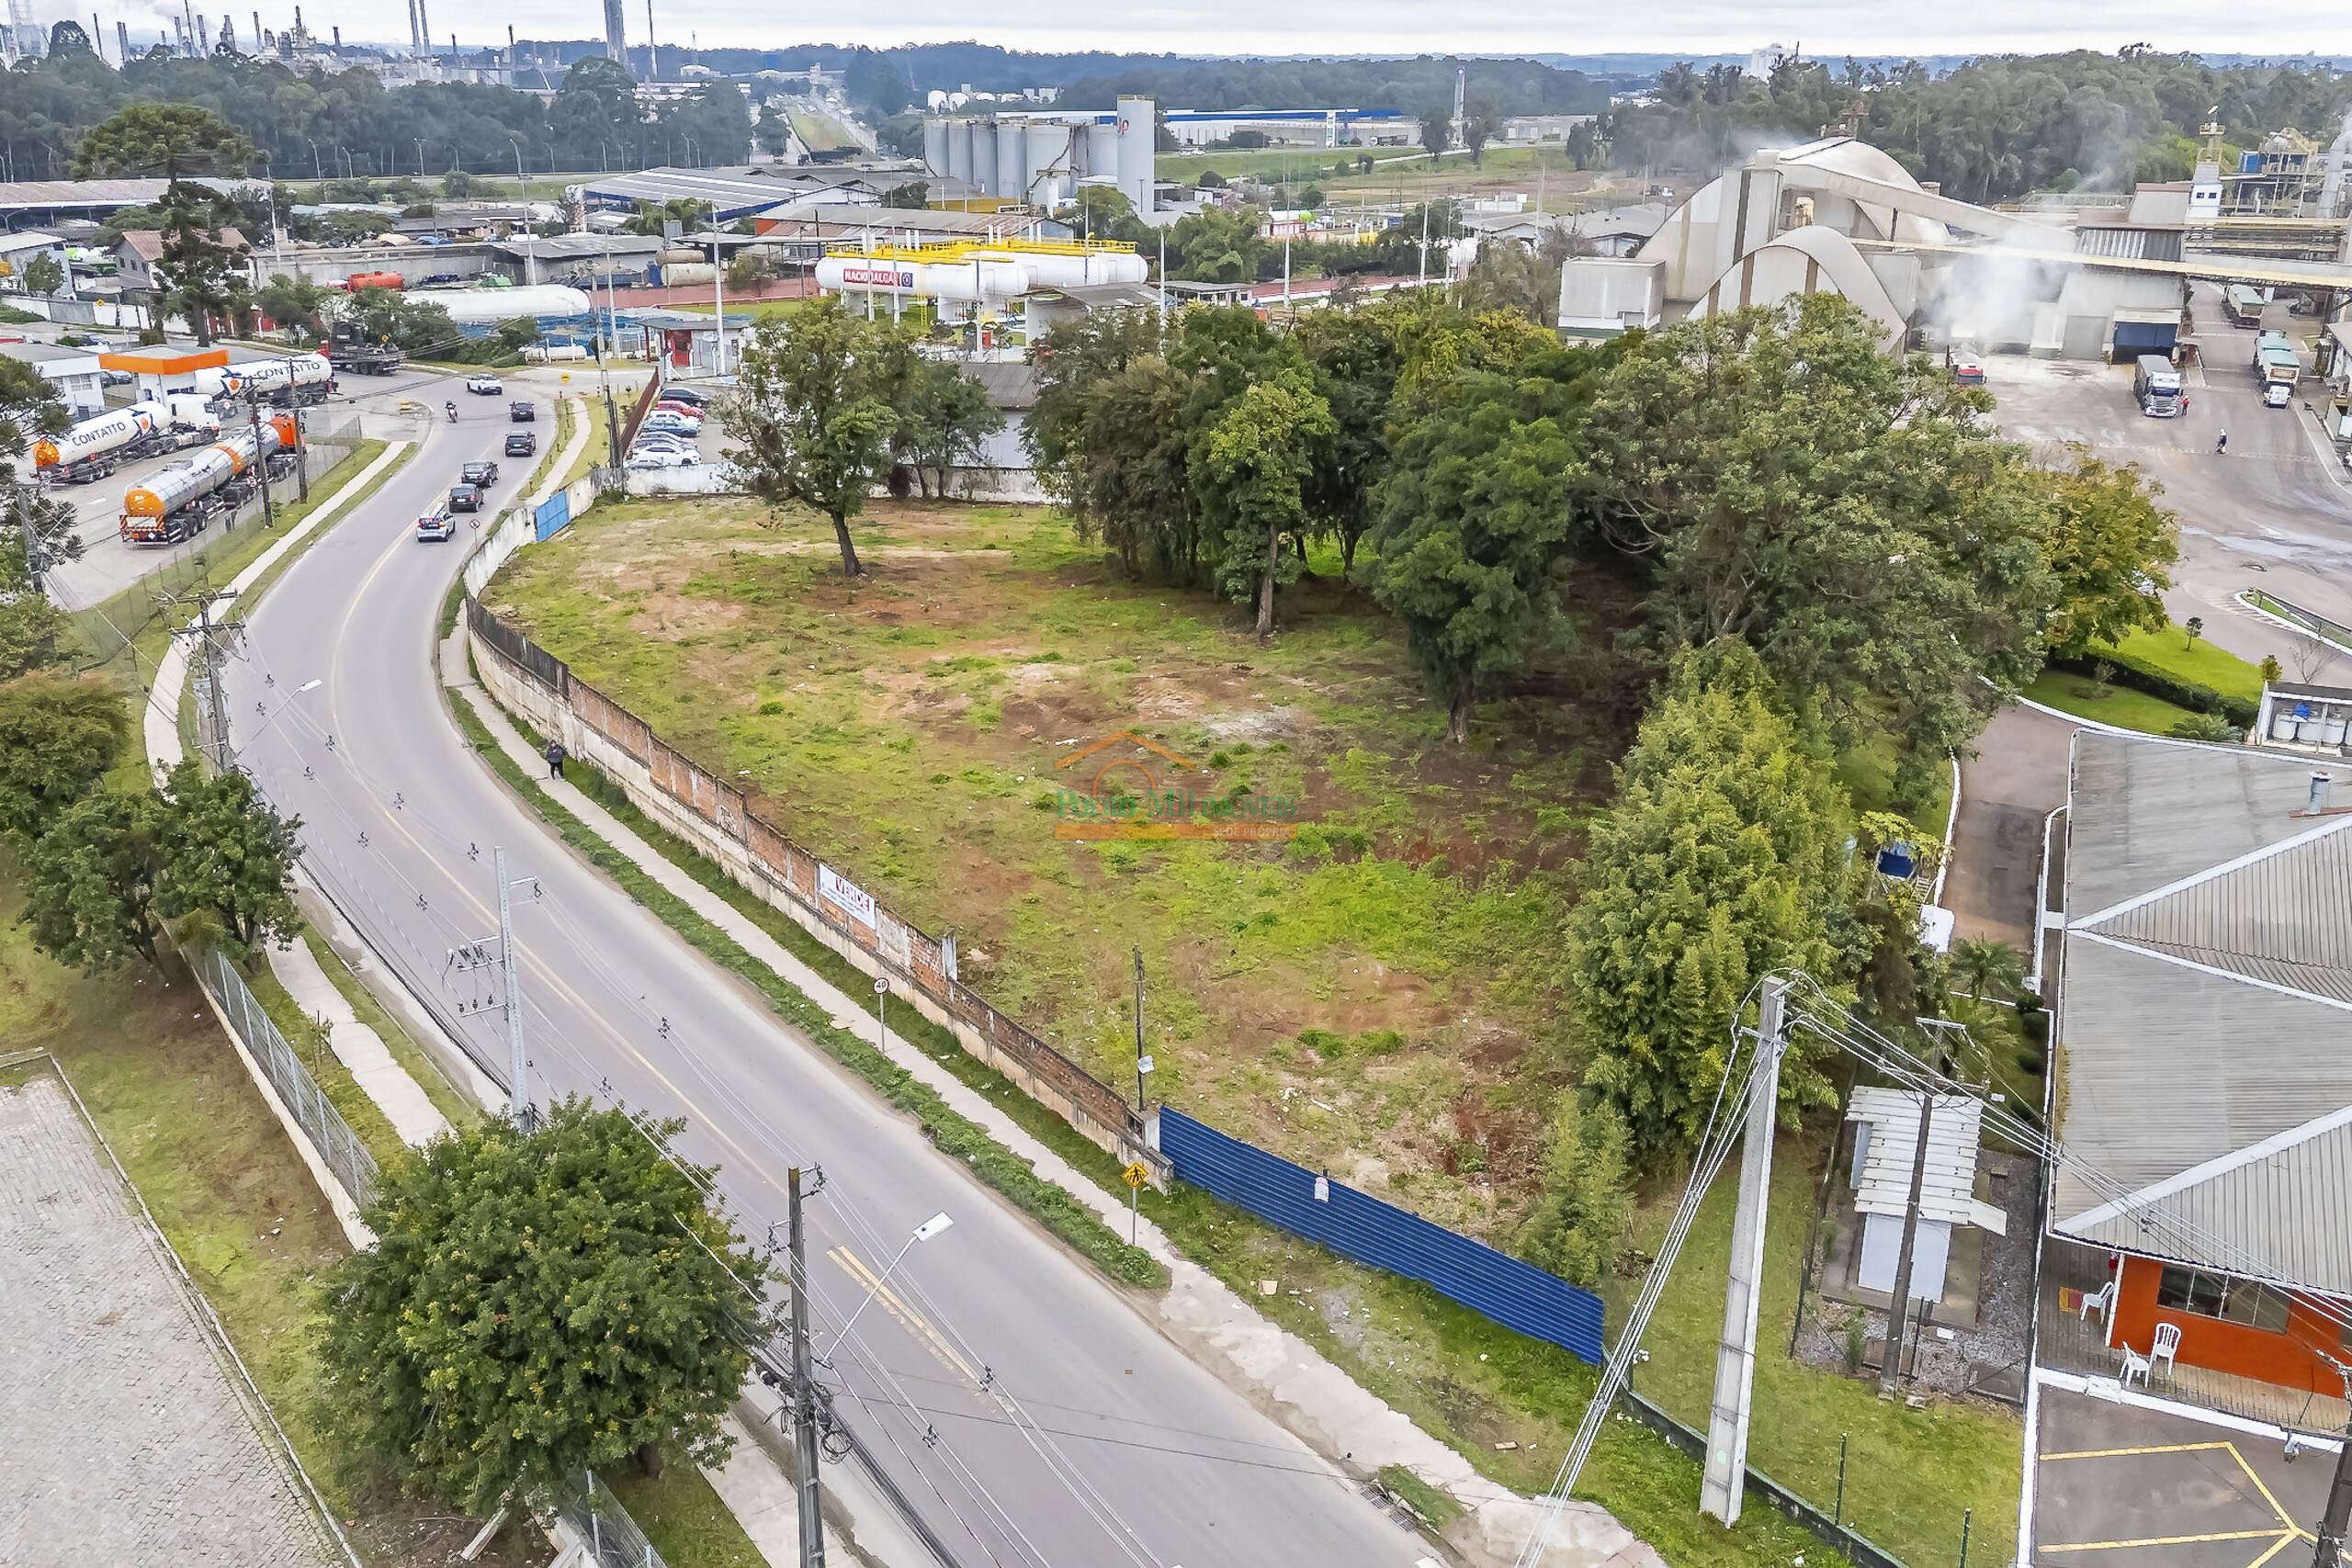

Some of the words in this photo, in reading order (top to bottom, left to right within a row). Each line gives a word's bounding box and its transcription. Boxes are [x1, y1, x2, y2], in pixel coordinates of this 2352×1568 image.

[256, 362, 321, 378] CONTATTO
[73, 422, 126, 446] CONTATTO
[835, 875, 870, 912] VENDE
[876, 980, 887, 990] 40
